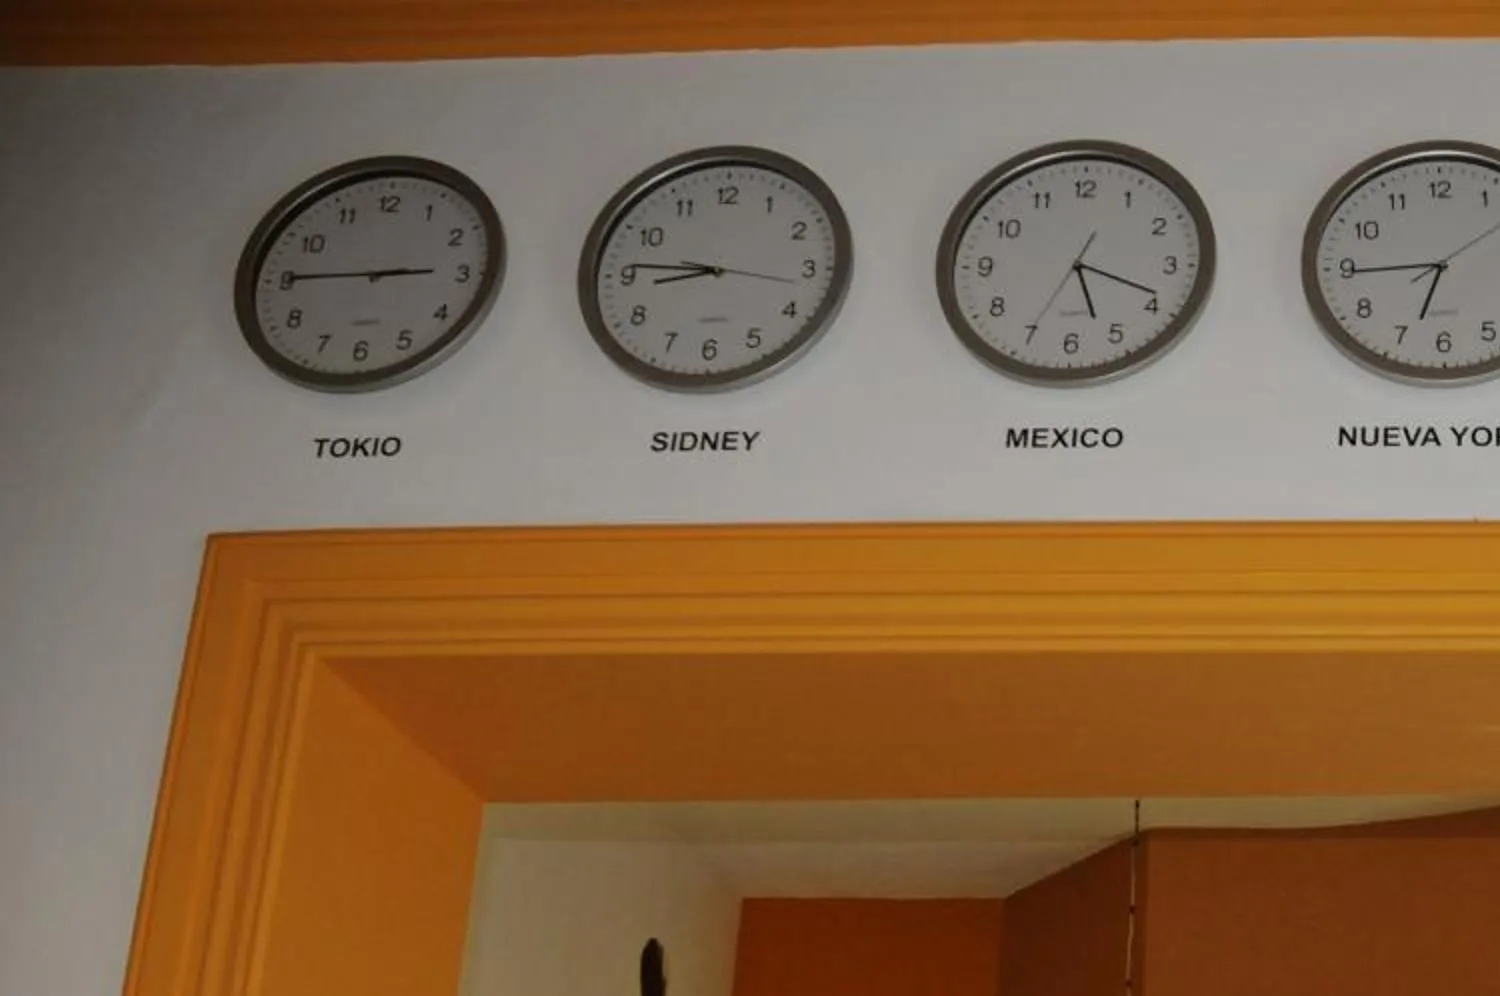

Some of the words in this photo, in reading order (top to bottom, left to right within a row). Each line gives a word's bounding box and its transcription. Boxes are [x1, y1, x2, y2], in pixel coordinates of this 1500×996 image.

[717, 185, 740, 205] 12
[1074, 179, 1097, 199] 12
[1429, 180, 1452, 199] 12
[1481, 189, 1489, 208] 1
[379, 195, 401, 214] 12
[676, 199, 694, 217] 11
[765, 195, 774, 214] 1
[1034, 191, 1051, 209] 11
[1124, 191, 1132, 209] 1
[1388, 193, 1406, 211] 11
[339, 207, 357, 225] 11
[425, 203, 434, 222] 1
[791, 221, 808, 241] 2
[997, 218, 1022, 239] 10
[1151, 217, 1168, 236] 2
[1354, 220, 1380, 241] 10
[302, 233, 326, 254] 10
[447, 227, 465, 247] 2
[640, 226, 664, 248] 10
[455, 264, 471, 284] 3
[801, 259, 817, 279] 3
[977, 256, 994, 278] 9
[1162, 255, 1178, 275] 3
[433, 303, 449, 321] 4
[630, 304, 647, 327] 8
[781, 301, 797, 319] 4
[989, 296, 1006, 318] 8
[1143, 297, 1159, 314] 4
[1356, 297, 1373, 319] 8
[286, 309, 303, 329] 8
[396, 329, 413, 351] 5
[745, 327, 762, 349] 5
[1024, 324, 1039, 345] 7
[1107, 323, 1124, 345] 5
[1394, 325, 1409, 345] 7
[1481, 320, 1497, 342] 5
[318, 334, 332, 353] 7
[352, 340, 369, 362] 6
[664, 331, 679, 353] 7
[701, 338, 718, 362] 6
[1063, 332, 1079, 355] 6
[1435, 330, 1453, 353] 6
[651, 431, 760, 452] SIDNEY
[1005, 427, 1124, 449] MEXICO
[1338, 425, 1441, 447] NUEVA
[314, 436, 402, 458] TOKIO
